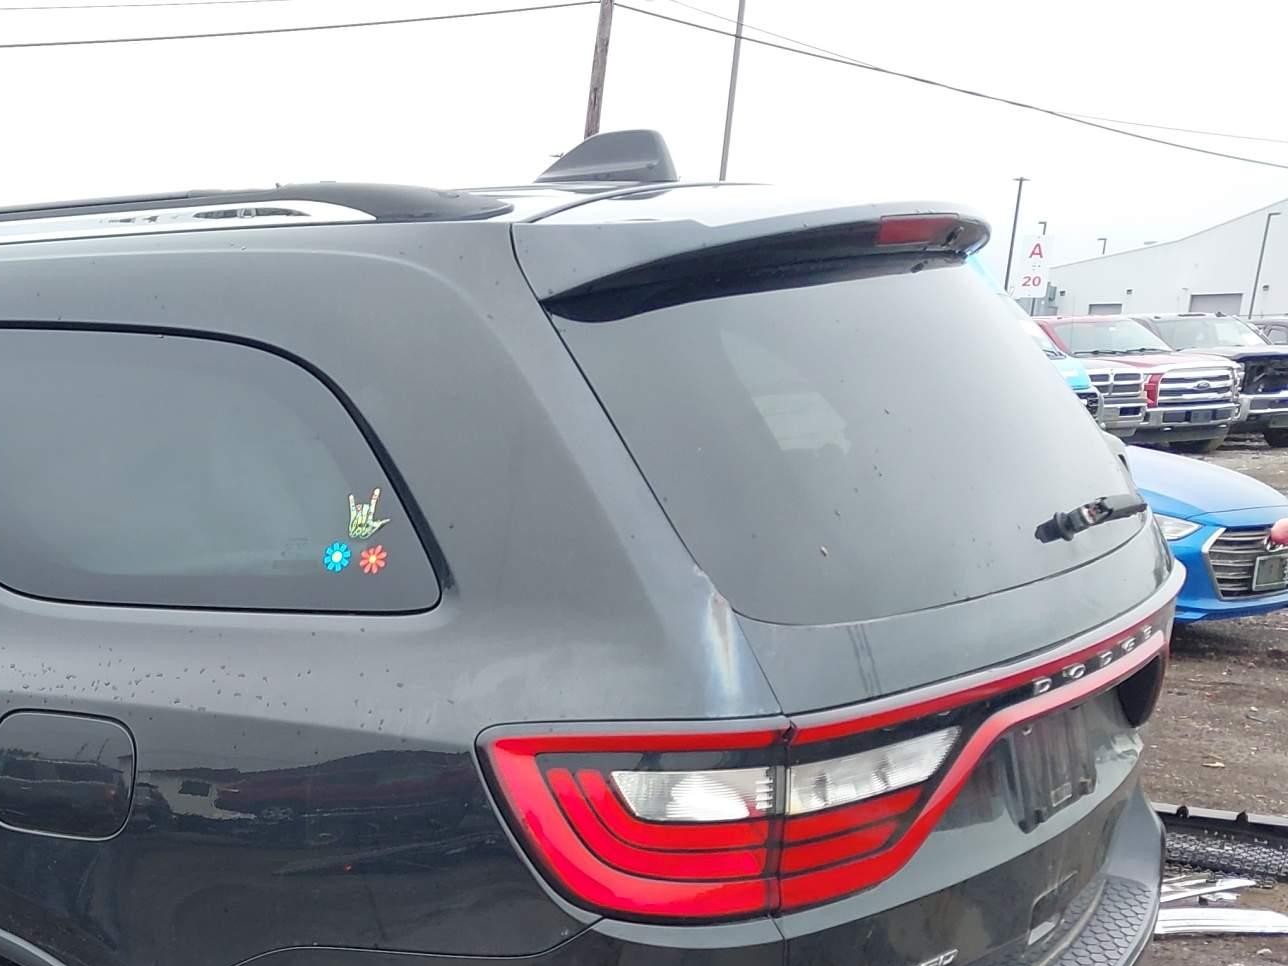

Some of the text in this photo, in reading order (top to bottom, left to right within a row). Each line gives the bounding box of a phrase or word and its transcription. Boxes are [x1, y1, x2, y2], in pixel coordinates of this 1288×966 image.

[1029, 242, 1043, 258] A
[1022, 276, 1041, 287] 20
[1033, 625, 1152, 696] DODGE
